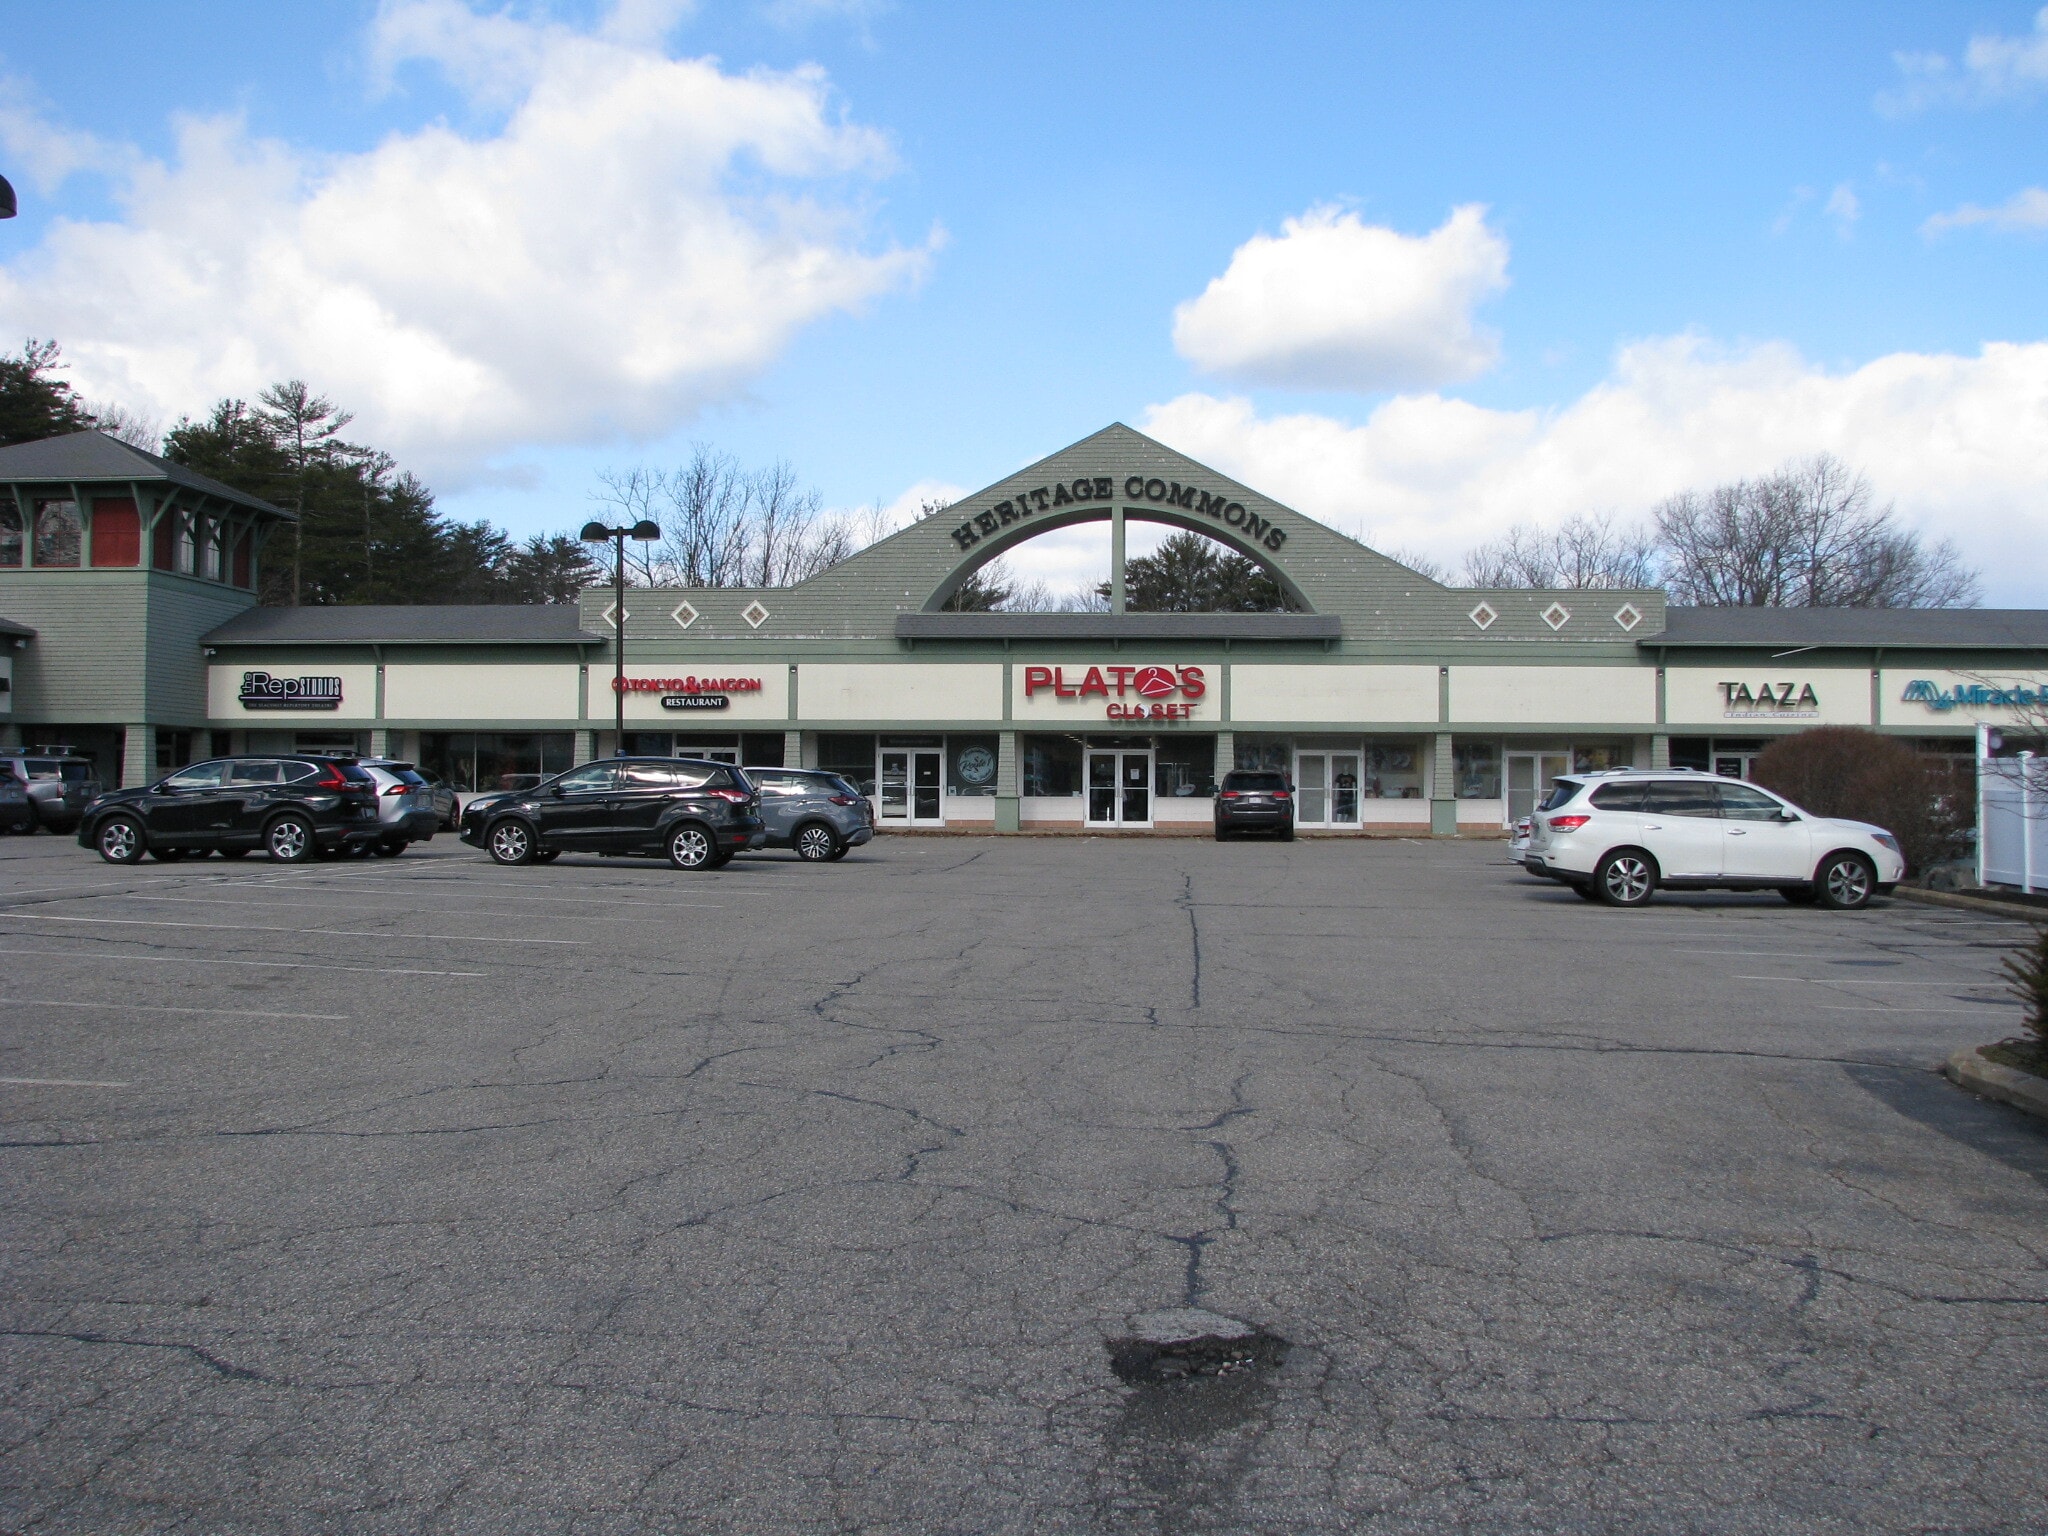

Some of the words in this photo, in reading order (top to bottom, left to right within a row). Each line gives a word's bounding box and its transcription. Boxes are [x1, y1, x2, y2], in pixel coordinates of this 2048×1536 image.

[950, 477, 1113, 550] HERITAGE
[1124, 476, 1287, 550] COMMONS
[241, 673, 253, 693] the
[252, 673, 298, 700] Rep
[300, 678, 340, 696] STUDIOS
[1025, 664, 1206, 698] PLATO'S
[666, 698, 723, 706] RESTAURANT
[1718, 682, 1818, 706] TAAZA
[1106, 703, 1197, 720] CLOSET
